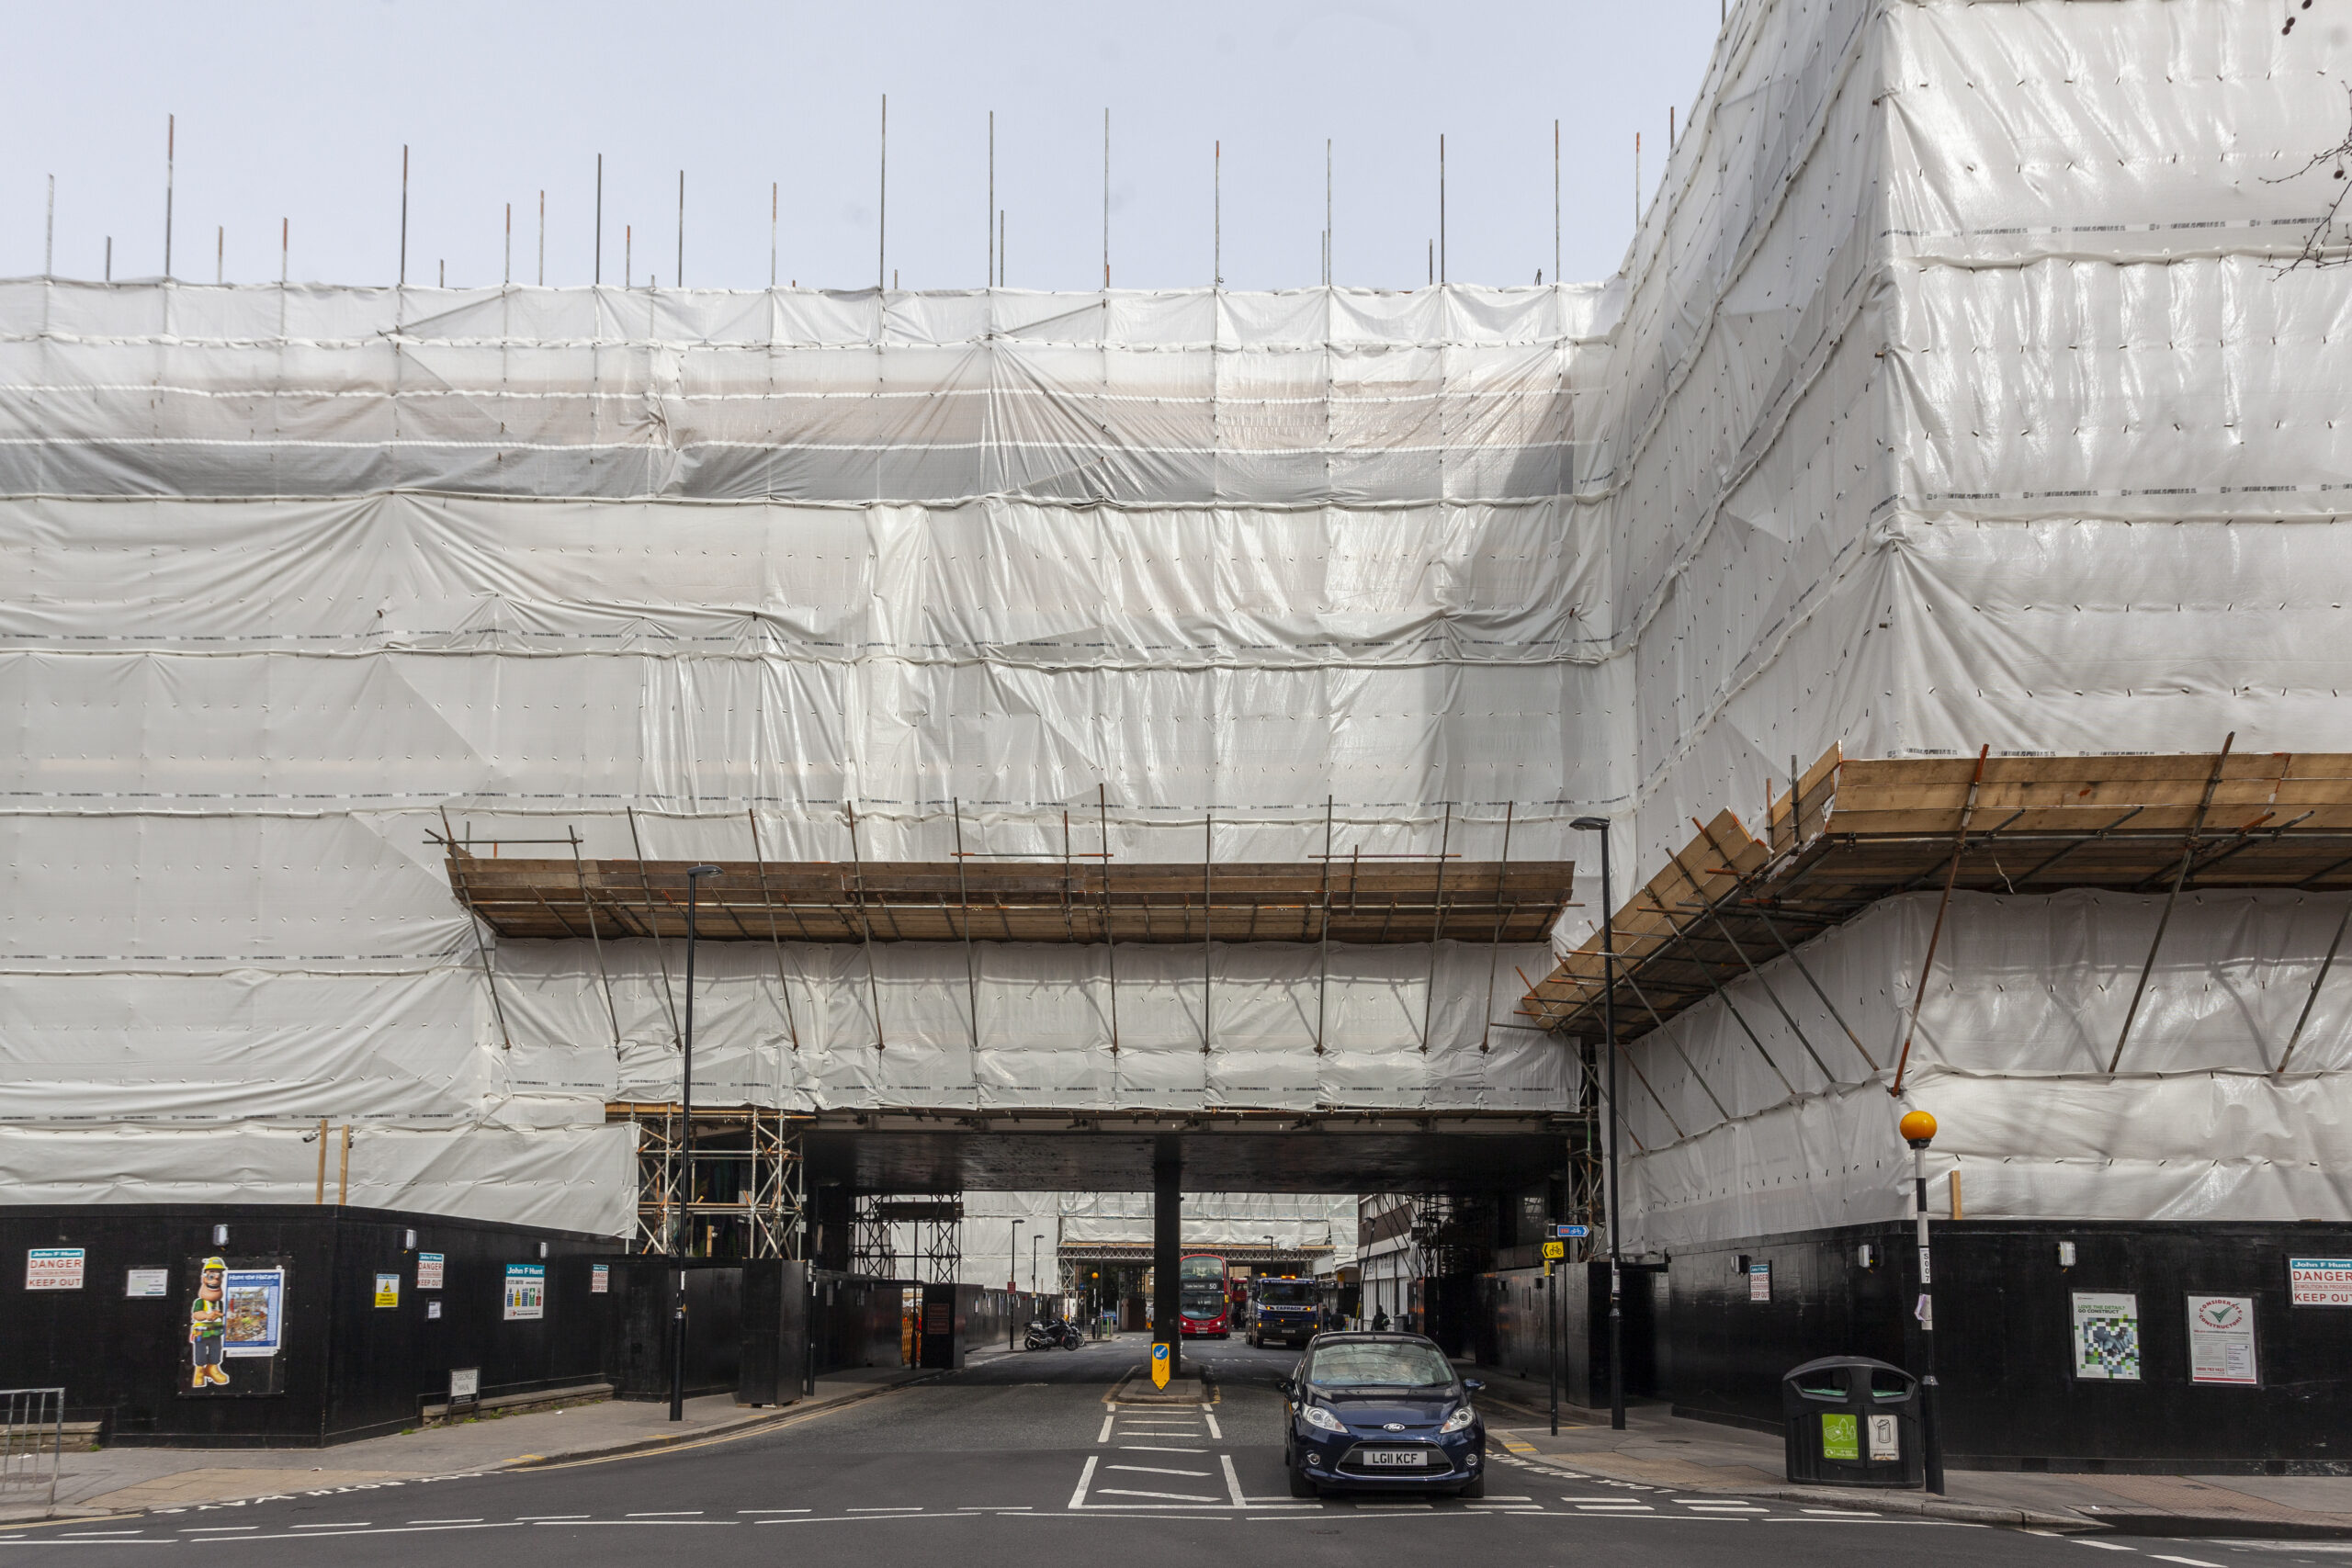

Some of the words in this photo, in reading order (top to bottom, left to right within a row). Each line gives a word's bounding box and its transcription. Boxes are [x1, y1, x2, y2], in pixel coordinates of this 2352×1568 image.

[30, 1259, 82, 1268] DANGER
[418, 1262, 442, 1270] DANGER
[529, 1267, 543, 1275] Hunt
[2292, 1270, 2352, 1281] DANGER
[59, 1278, 81, 1286] OUT
[1750, 1274, 1769, 1282] DANGER
[1750, 1291, 1760, 1299] KEEP
[1761, 1291, 1770, 1299] OUT
[2294, 1293, 2327, 1303] KEEP
[2331, 1293, 2352, 1303] OU
[2199, 1299, 2243, 1313] CONSIDERATE
[2199, 1314, 2243, 1329] CONSTRUCTORS
[1373, 1453, 1394, 1464] LG11
[1396, 1453, 1418, 1464] KCF
[410, 1470, 503, 1483] LOOK
[305, 1481, 406, 1497] BOTH
[1590, 1479, 1679, 1494] LOOK
[152, 1495, 298, 1514] WAYS
